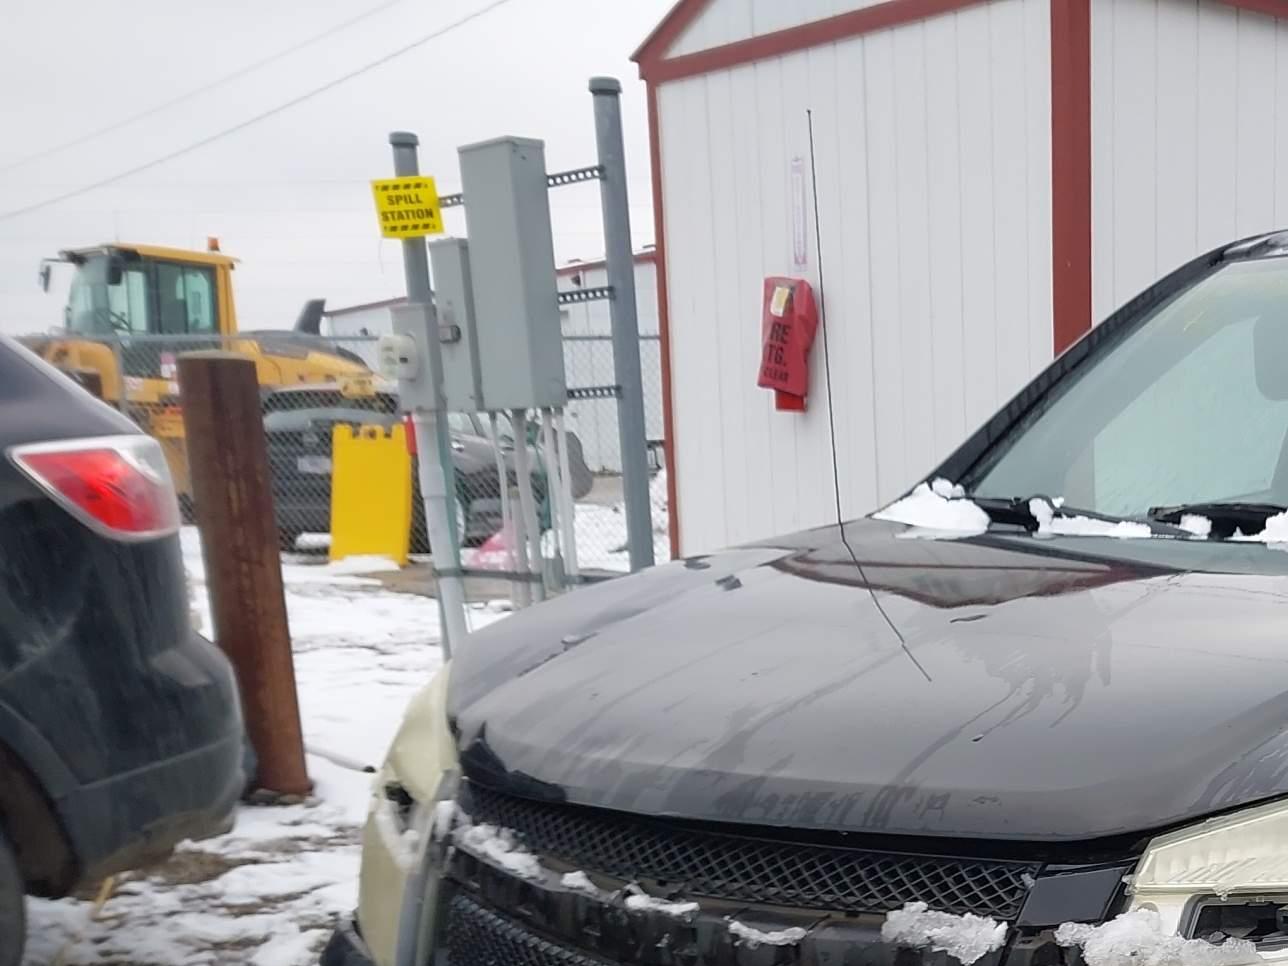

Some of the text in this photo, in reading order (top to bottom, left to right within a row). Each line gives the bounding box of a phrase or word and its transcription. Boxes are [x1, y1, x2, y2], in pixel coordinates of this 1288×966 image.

[386, 193, 423, 206] SPILL
[381, 208, 434, 222] STATION
[770, 322, 791, 344] RE
